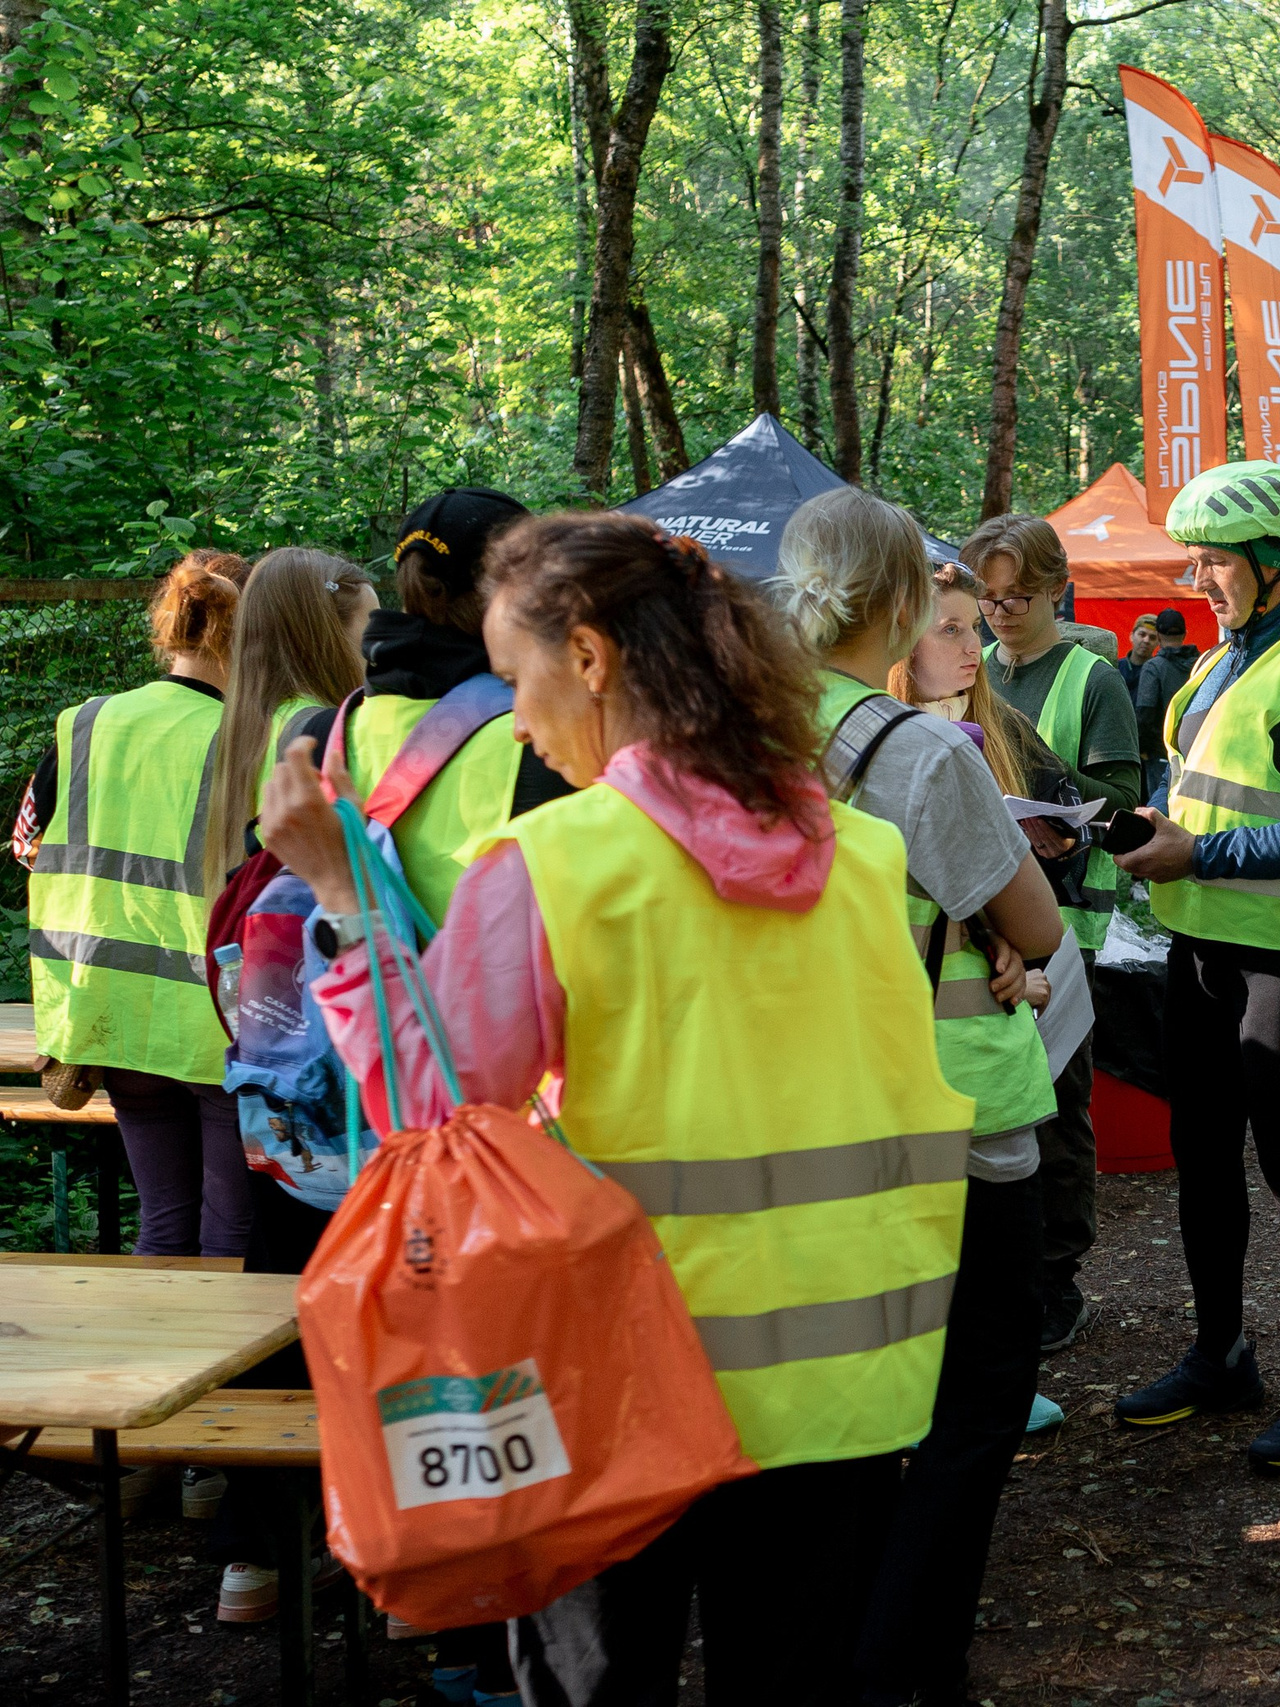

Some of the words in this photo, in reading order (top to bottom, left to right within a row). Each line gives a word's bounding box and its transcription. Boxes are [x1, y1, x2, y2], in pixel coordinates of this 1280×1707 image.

[654, 515, 771, 535] NATURAL
[664, 528, 734, 545] OWER
[419, 1433, 535, 1488] 8700
